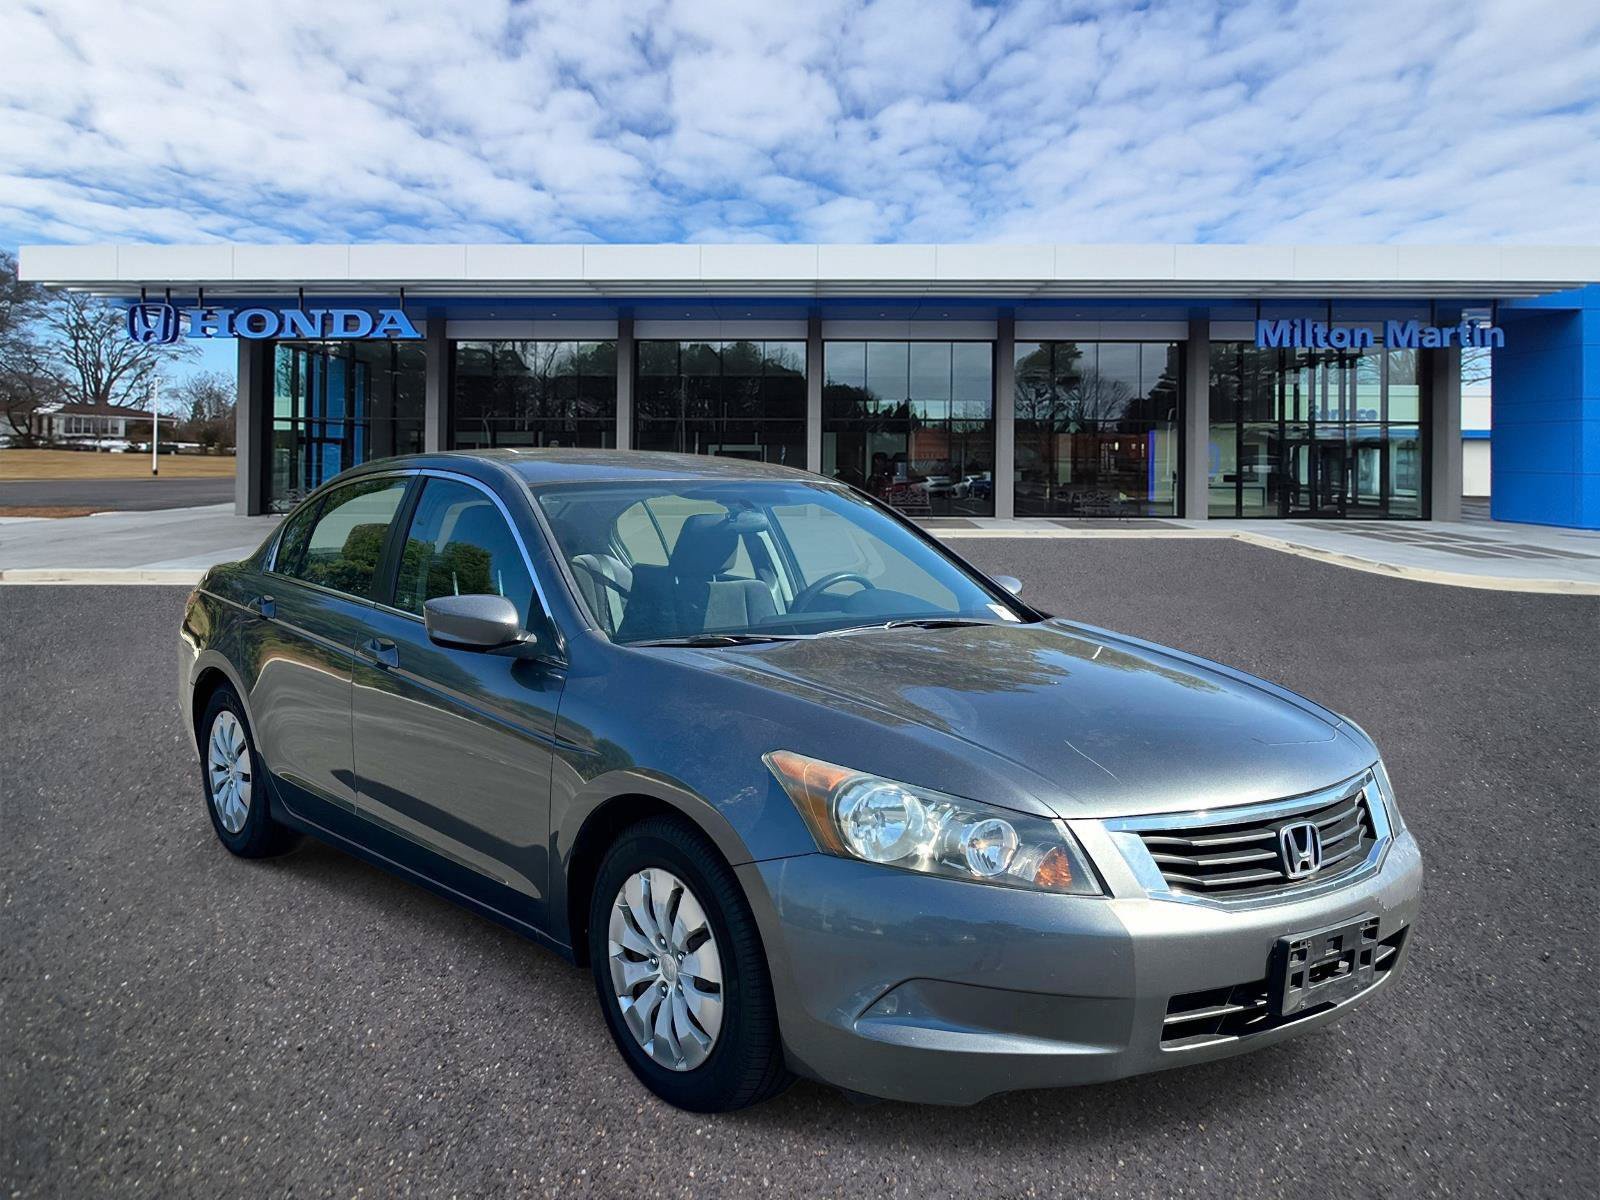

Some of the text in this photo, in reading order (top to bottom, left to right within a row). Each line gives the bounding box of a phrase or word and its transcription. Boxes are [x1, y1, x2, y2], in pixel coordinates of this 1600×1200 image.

[189, 307, 421, 340] HONDA
[1256, 318, 1505, 349] Milton Martin
